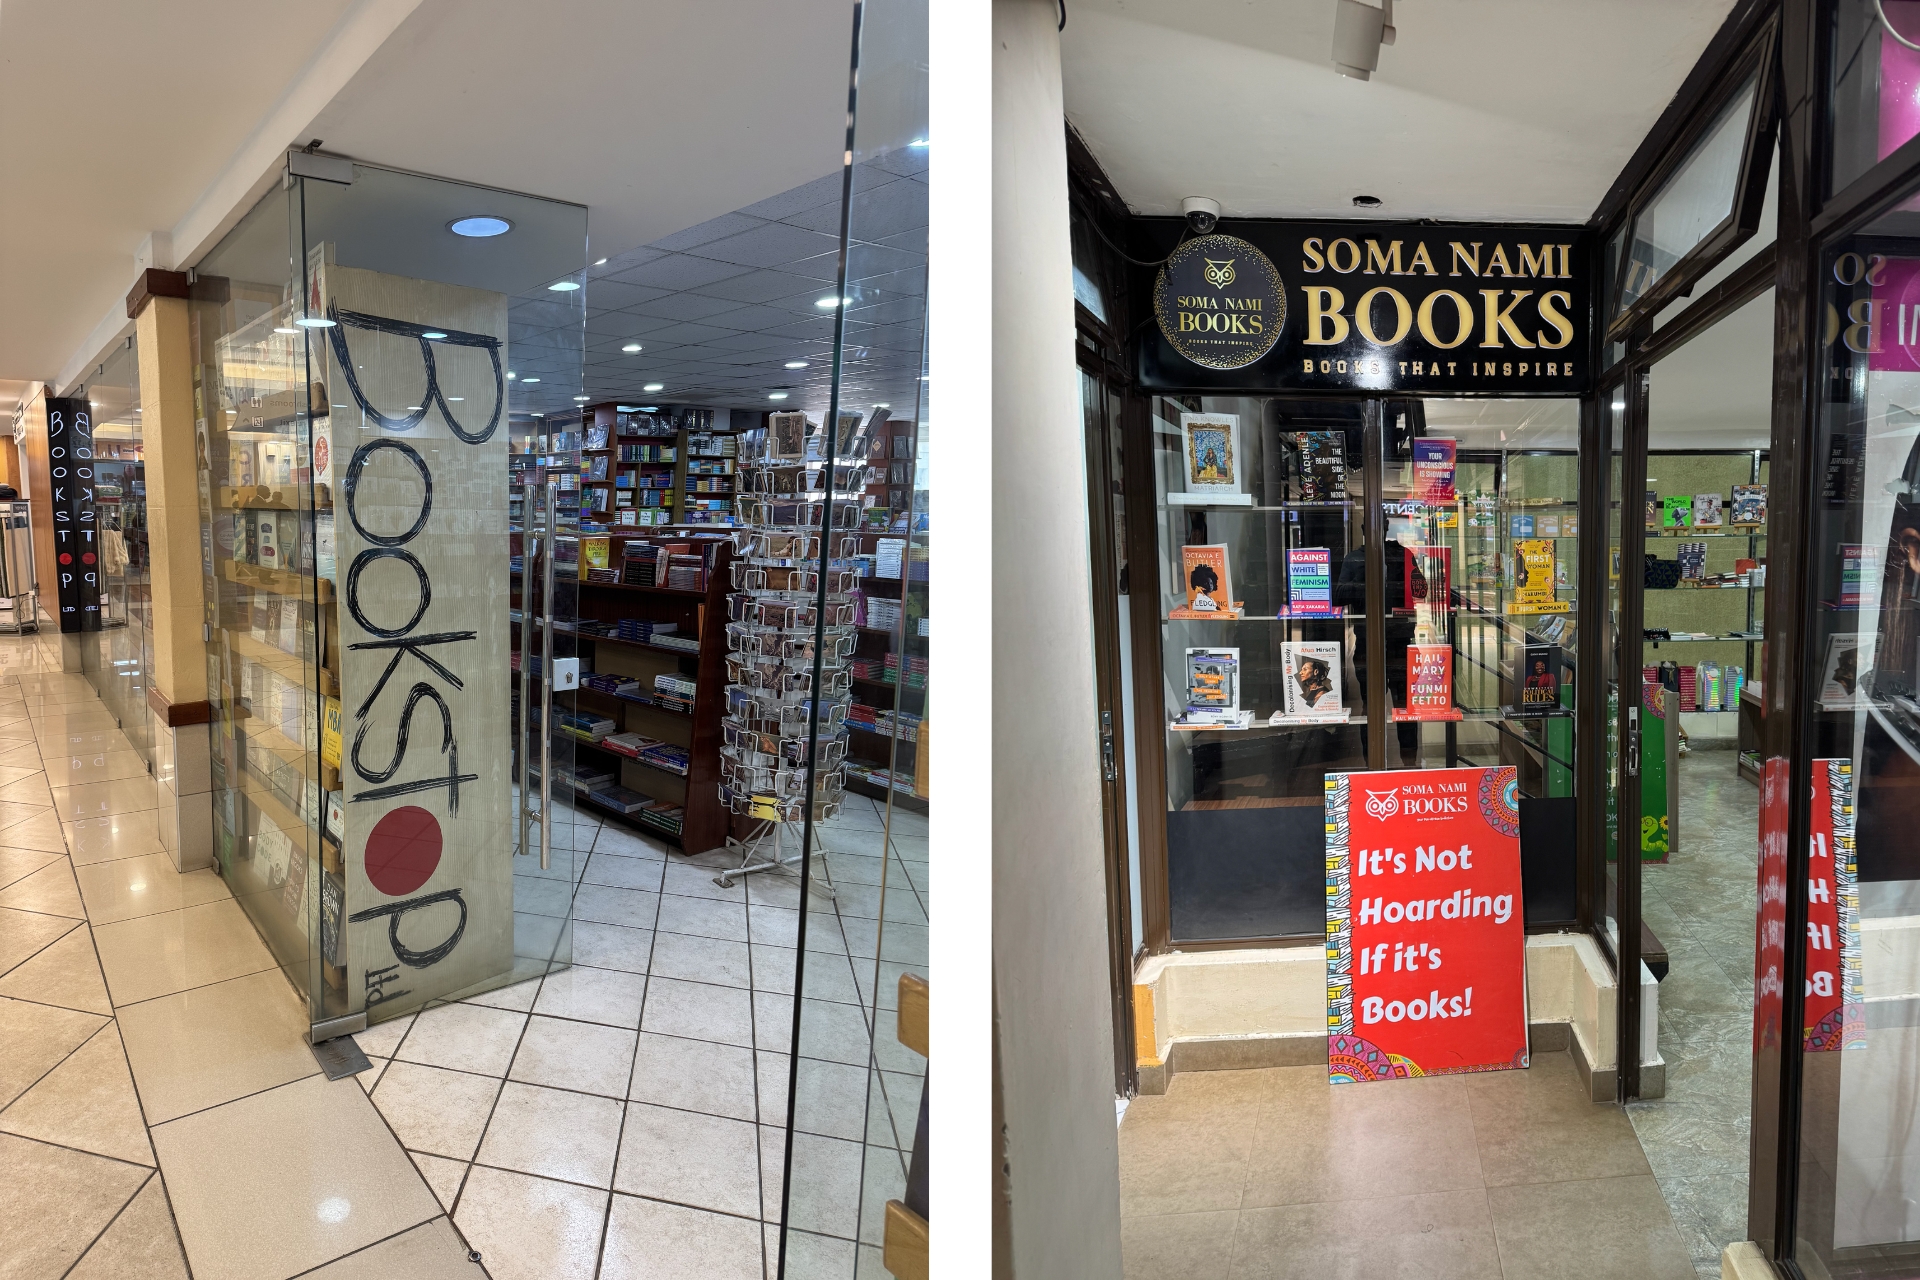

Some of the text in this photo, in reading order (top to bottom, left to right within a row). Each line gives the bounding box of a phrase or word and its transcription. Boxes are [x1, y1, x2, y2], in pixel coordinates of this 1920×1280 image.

[1302, 237, 1572, 279] SOMA NAMI
[1177, 295, 1262, 311] SOMA NAMI
[1178, 312, 1263, 334] BOOKS
[1301, 285, 1574, 349] BOOKS
[1303, 359, 1573, 376] BOOKS THAT INSPIRE
[1428, 452, 1442, 460] YOUR
[1301, 437, 1314, 498] LEYE ADENLE
[1416, 461, 1454, 470] UNCONSCIOUS
[1186, 559, 1222, 567] BUTLER
[1526, 555, 1549, 563] FIRST
[1415, 654, 1442, 663] HAIL
[1286, 665, 1292, 674] My
[1412, 666, 1445, 675] MARY
[1286, 675, 1295, 713] Decolonising
[1411, 685, 1447, 693] FUNMI
[1412, 696, 1446, 705] FETTO
[1523, 694, 1555, 702] RULES
[1402, 782, 1467, 795] SOMA NAMI
[1403, 796, 1468, 815] BOOKS
[1358, 844, 1473, 876] It's Not
[327, 883, 338, 899] DAN
[1358, 888, 1514, 926] Hoarding
[1360, 941, 1443, 975] If it's
[1361, 987, 1473, 1025] Books!
